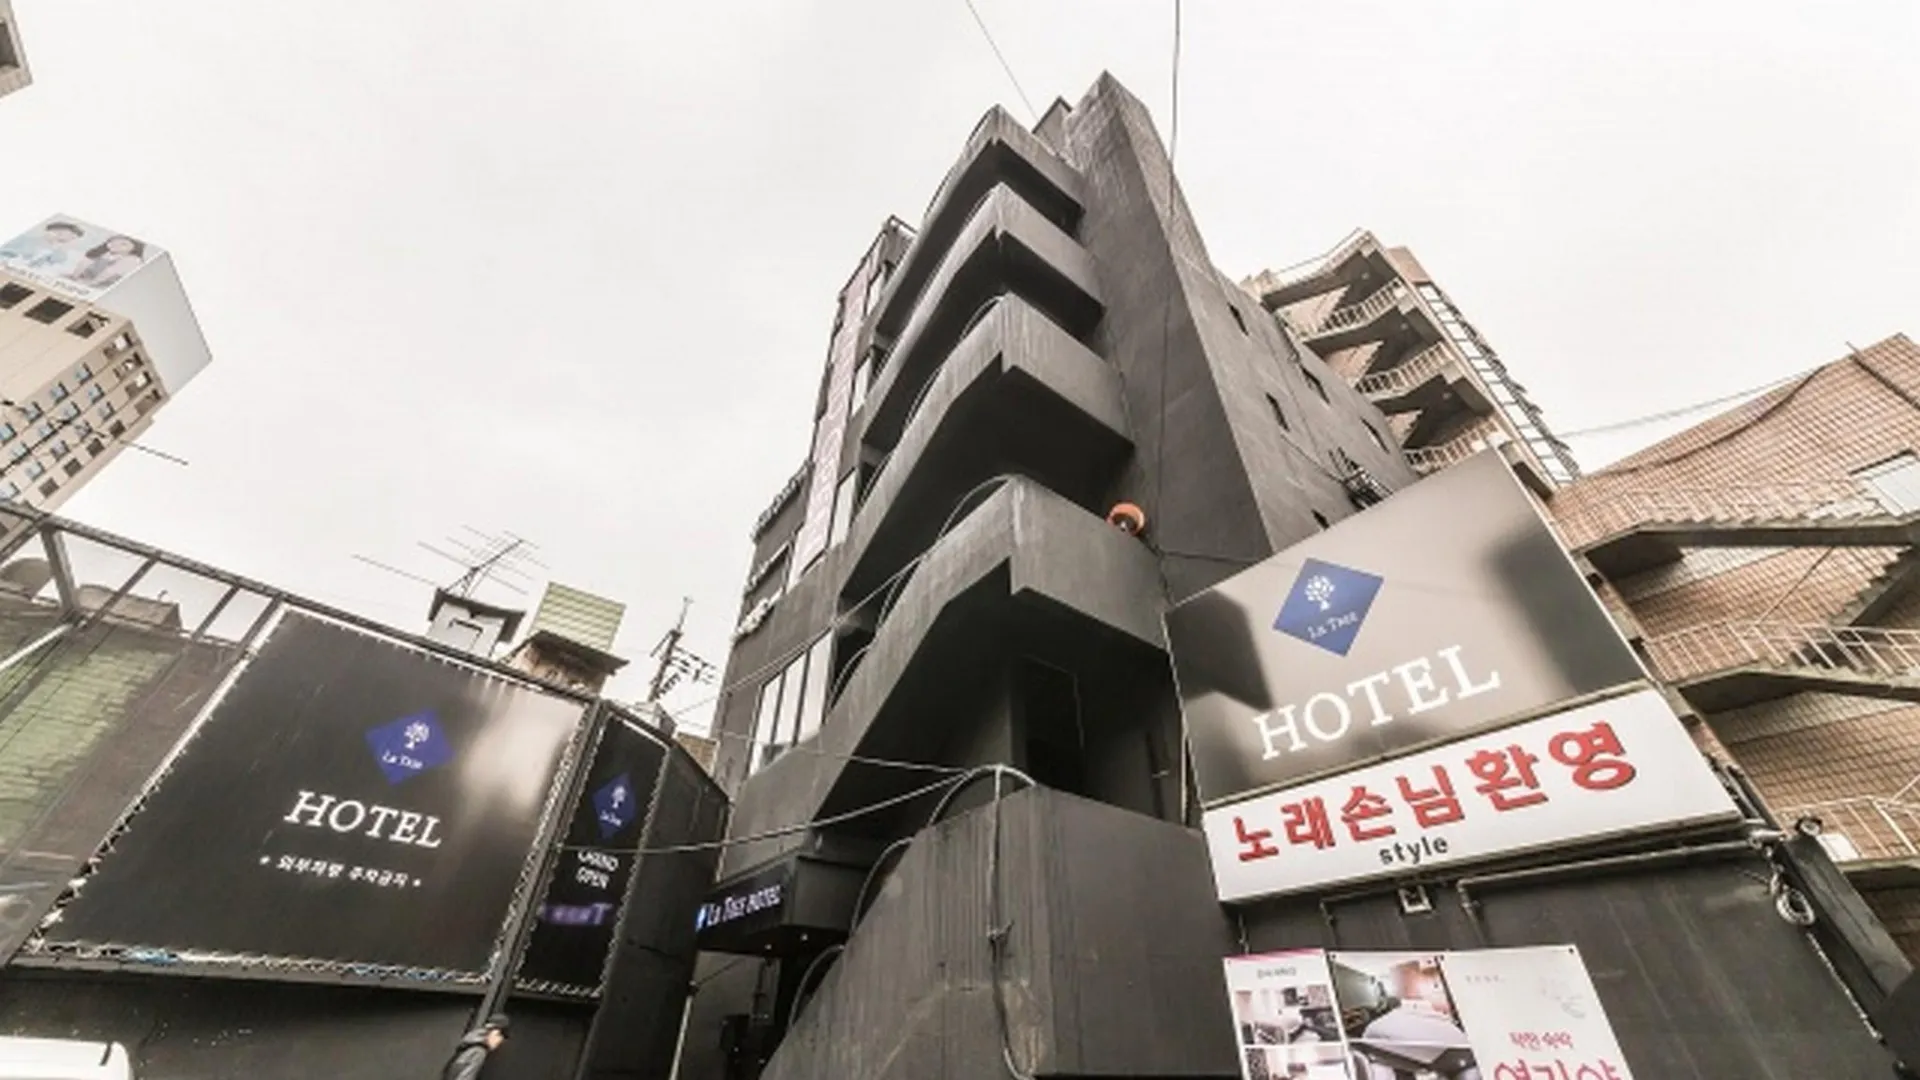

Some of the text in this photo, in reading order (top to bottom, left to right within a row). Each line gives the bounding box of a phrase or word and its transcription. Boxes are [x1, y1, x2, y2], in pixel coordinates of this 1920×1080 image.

[1253, 645, 1501, 760] HOTEL
[284, 788, 442, 848] HOTEL
[1233, 721, 1637, 862] 노래손님환영
[1379, 836, 1448, 865] style
